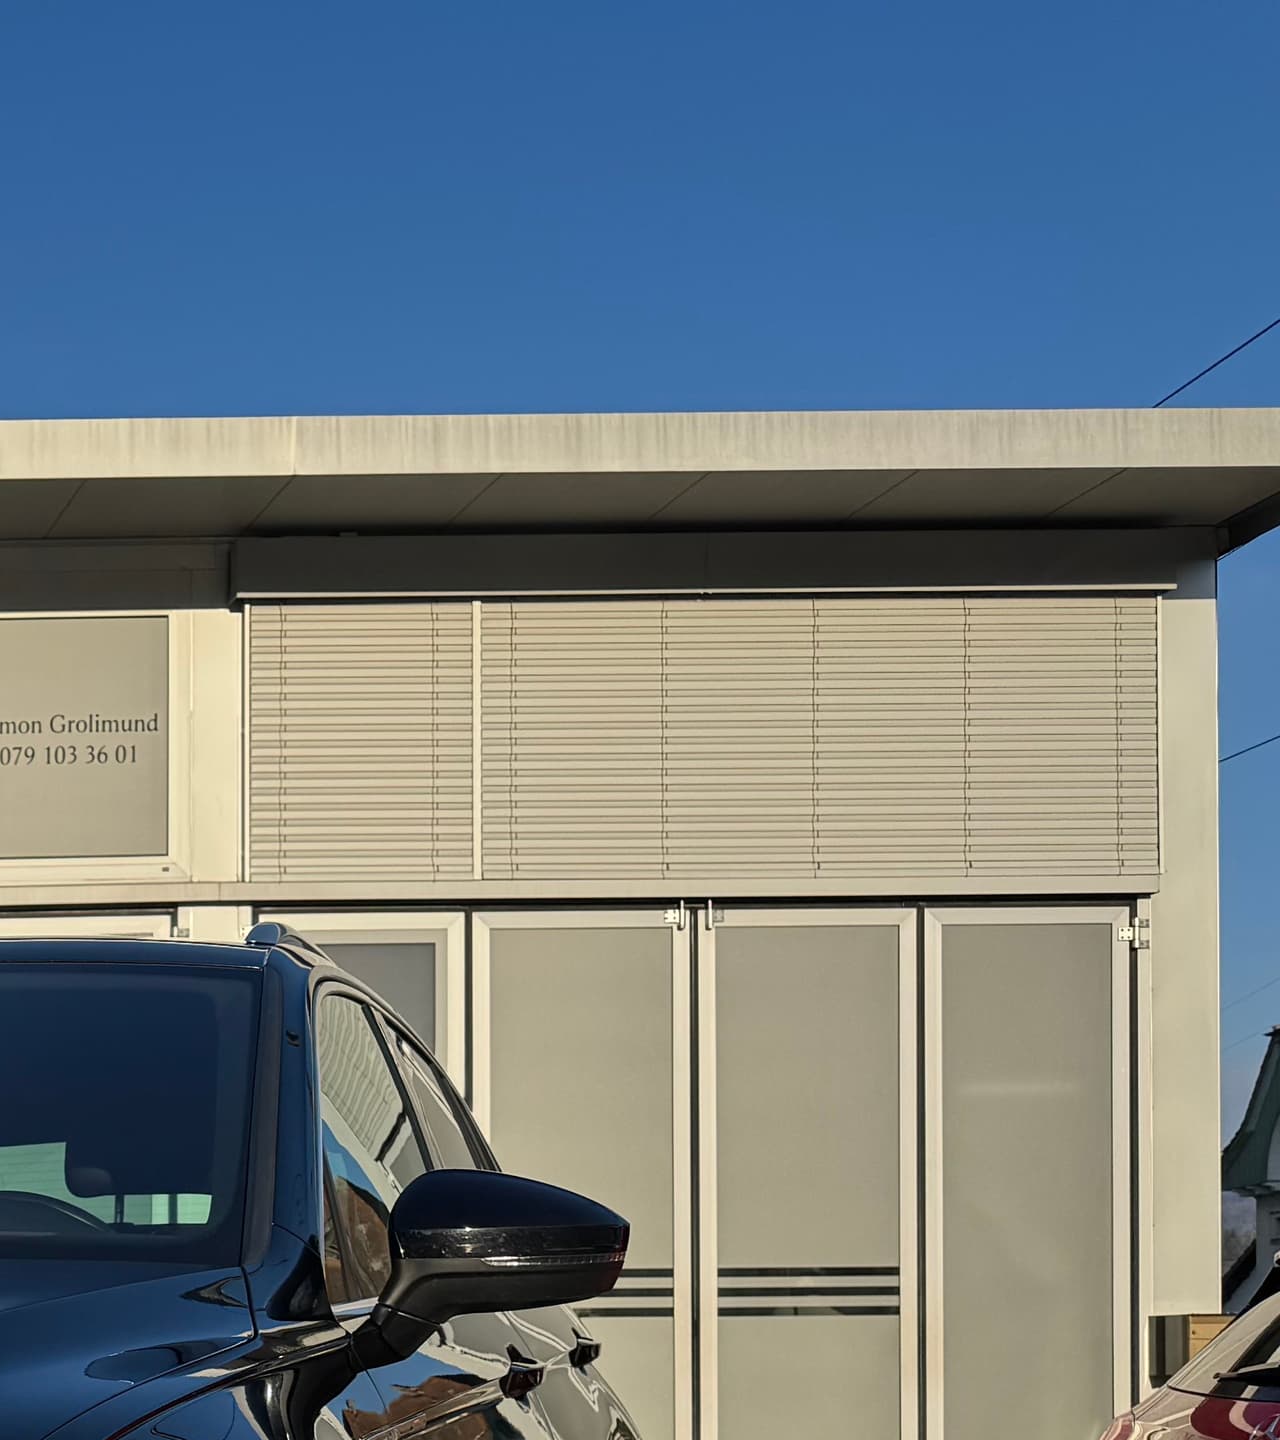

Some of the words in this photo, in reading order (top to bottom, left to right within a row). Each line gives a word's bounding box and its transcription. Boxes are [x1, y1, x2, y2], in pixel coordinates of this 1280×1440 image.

[49, 713, 159, 734] Grolimund
[0, 746, 36, 766] 079
[45, 745, 78, 765] 103
[85, 744, 109, 764] 36
[115, 744, 137, 764] 01
